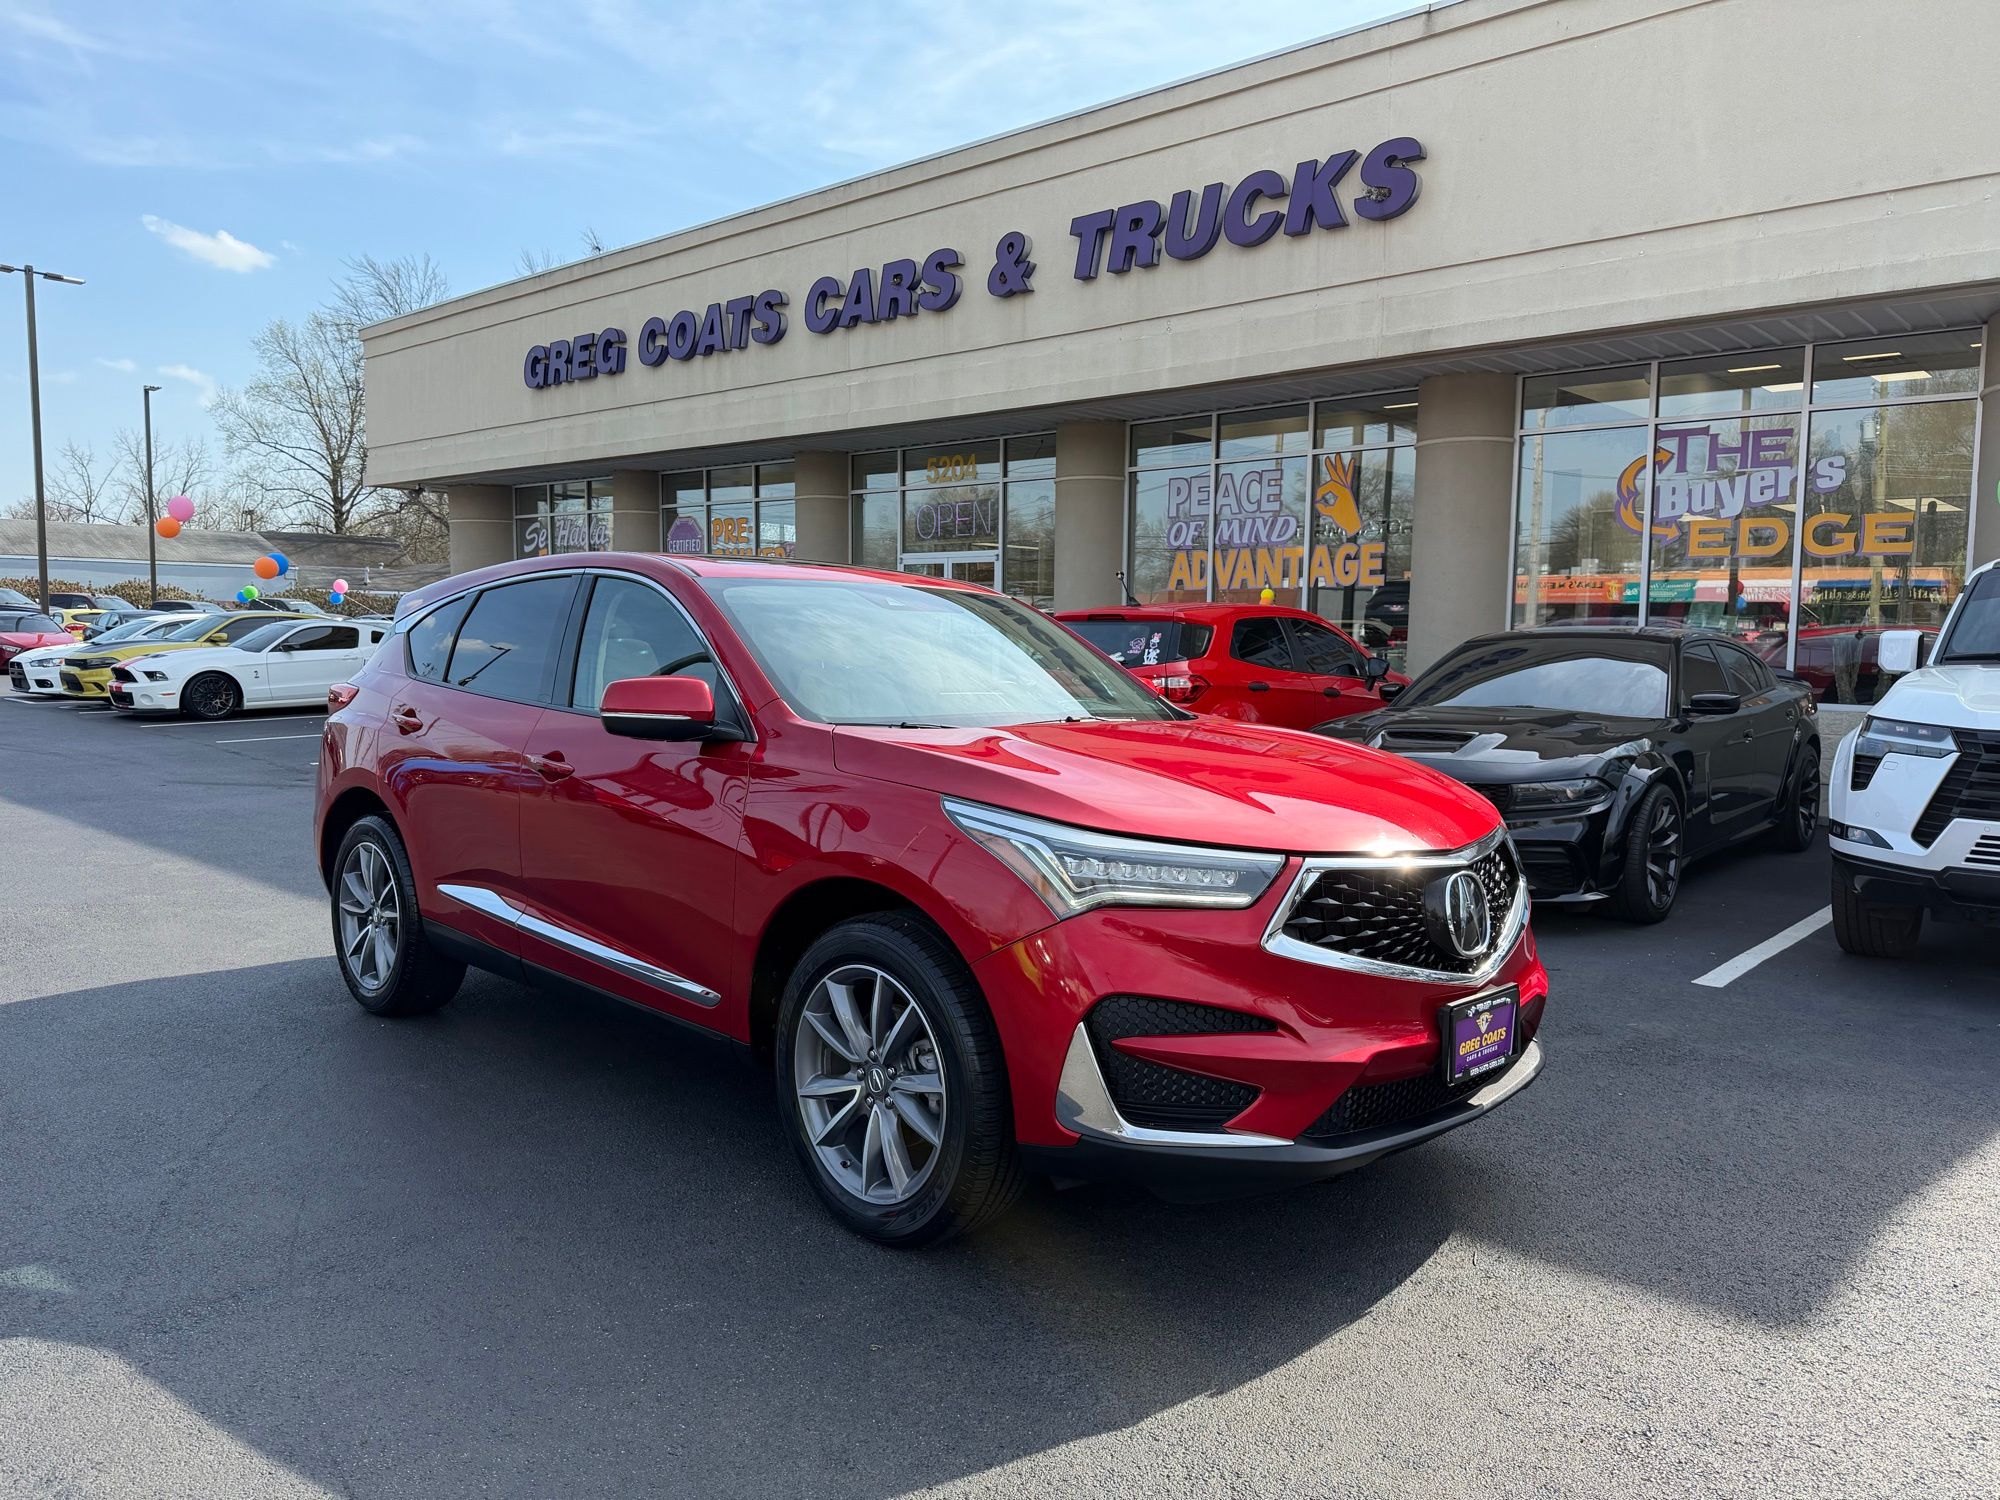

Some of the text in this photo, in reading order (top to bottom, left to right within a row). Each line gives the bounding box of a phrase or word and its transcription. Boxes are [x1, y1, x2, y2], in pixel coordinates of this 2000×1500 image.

[524, 136, 1427, 389] GREG COATS CARS & TRUCKS
[926, 453, 978, 484] 5204
[1656, 424, 1794, 474] THE
[1167, 469, 1284, 519] PEACE
[1654, 454, 1847, 521] Buyer's
[523, 516, 607, 552] Se Habla
[711, 517, 753, 545] PRE-
[916, 499, 991, 539] OPEN
[1167, 519, 1204, 549] OF
[1214, 516, 1298, 547] MIND
[1687, 511, 1915, 559] EDGE
[668, 539, 701, 553] CERTIFIED
[1167, 542, 1386, 590] ADVANTAGE
[1460, 1027, 1507, 1056] GREG COATS
